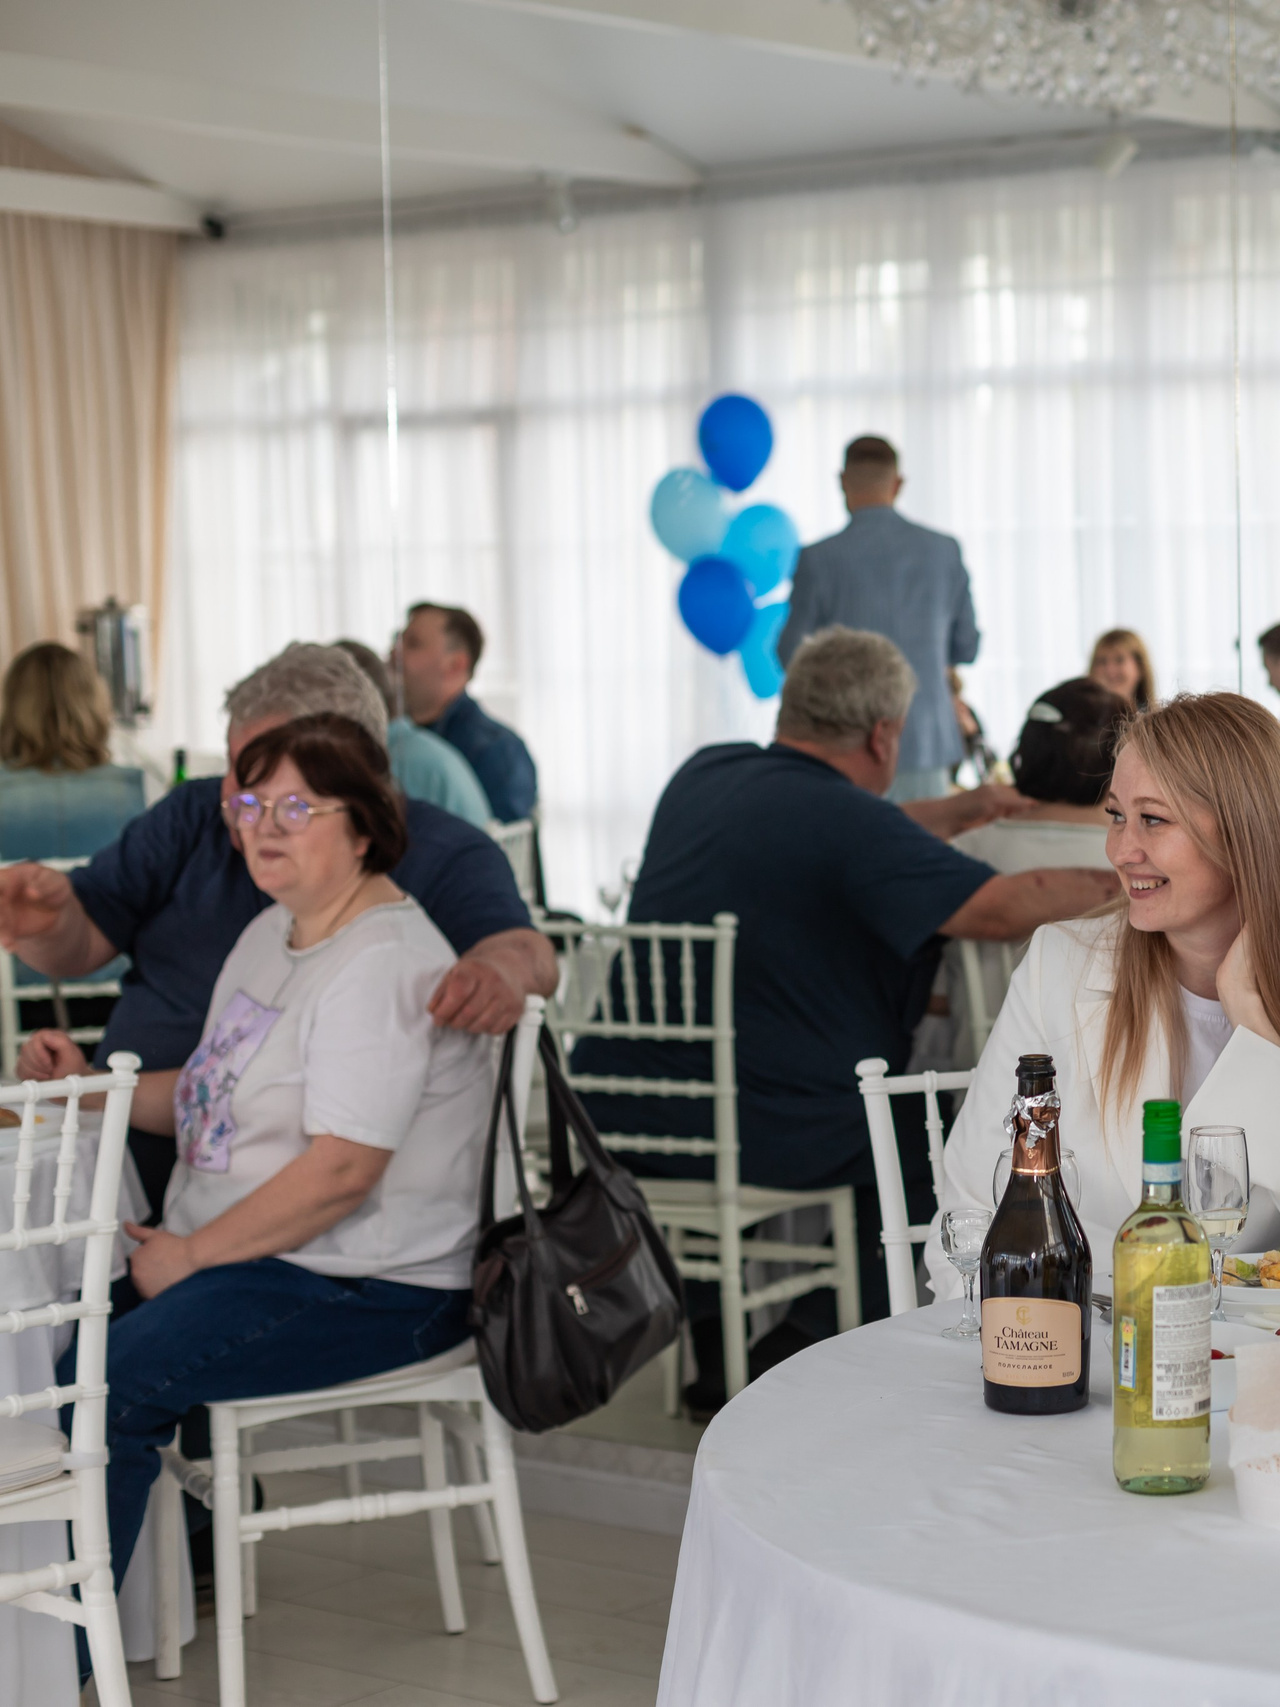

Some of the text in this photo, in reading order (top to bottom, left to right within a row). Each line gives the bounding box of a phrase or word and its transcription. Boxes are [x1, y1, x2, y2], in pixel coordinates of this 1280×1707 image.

[1002, 1326, 1049, 1339] Château
[994, 1335, 1058, 1352] TAMAGNE
[997, 1361, 1053, 1371] ПОЛУСЛАДКОЕ
